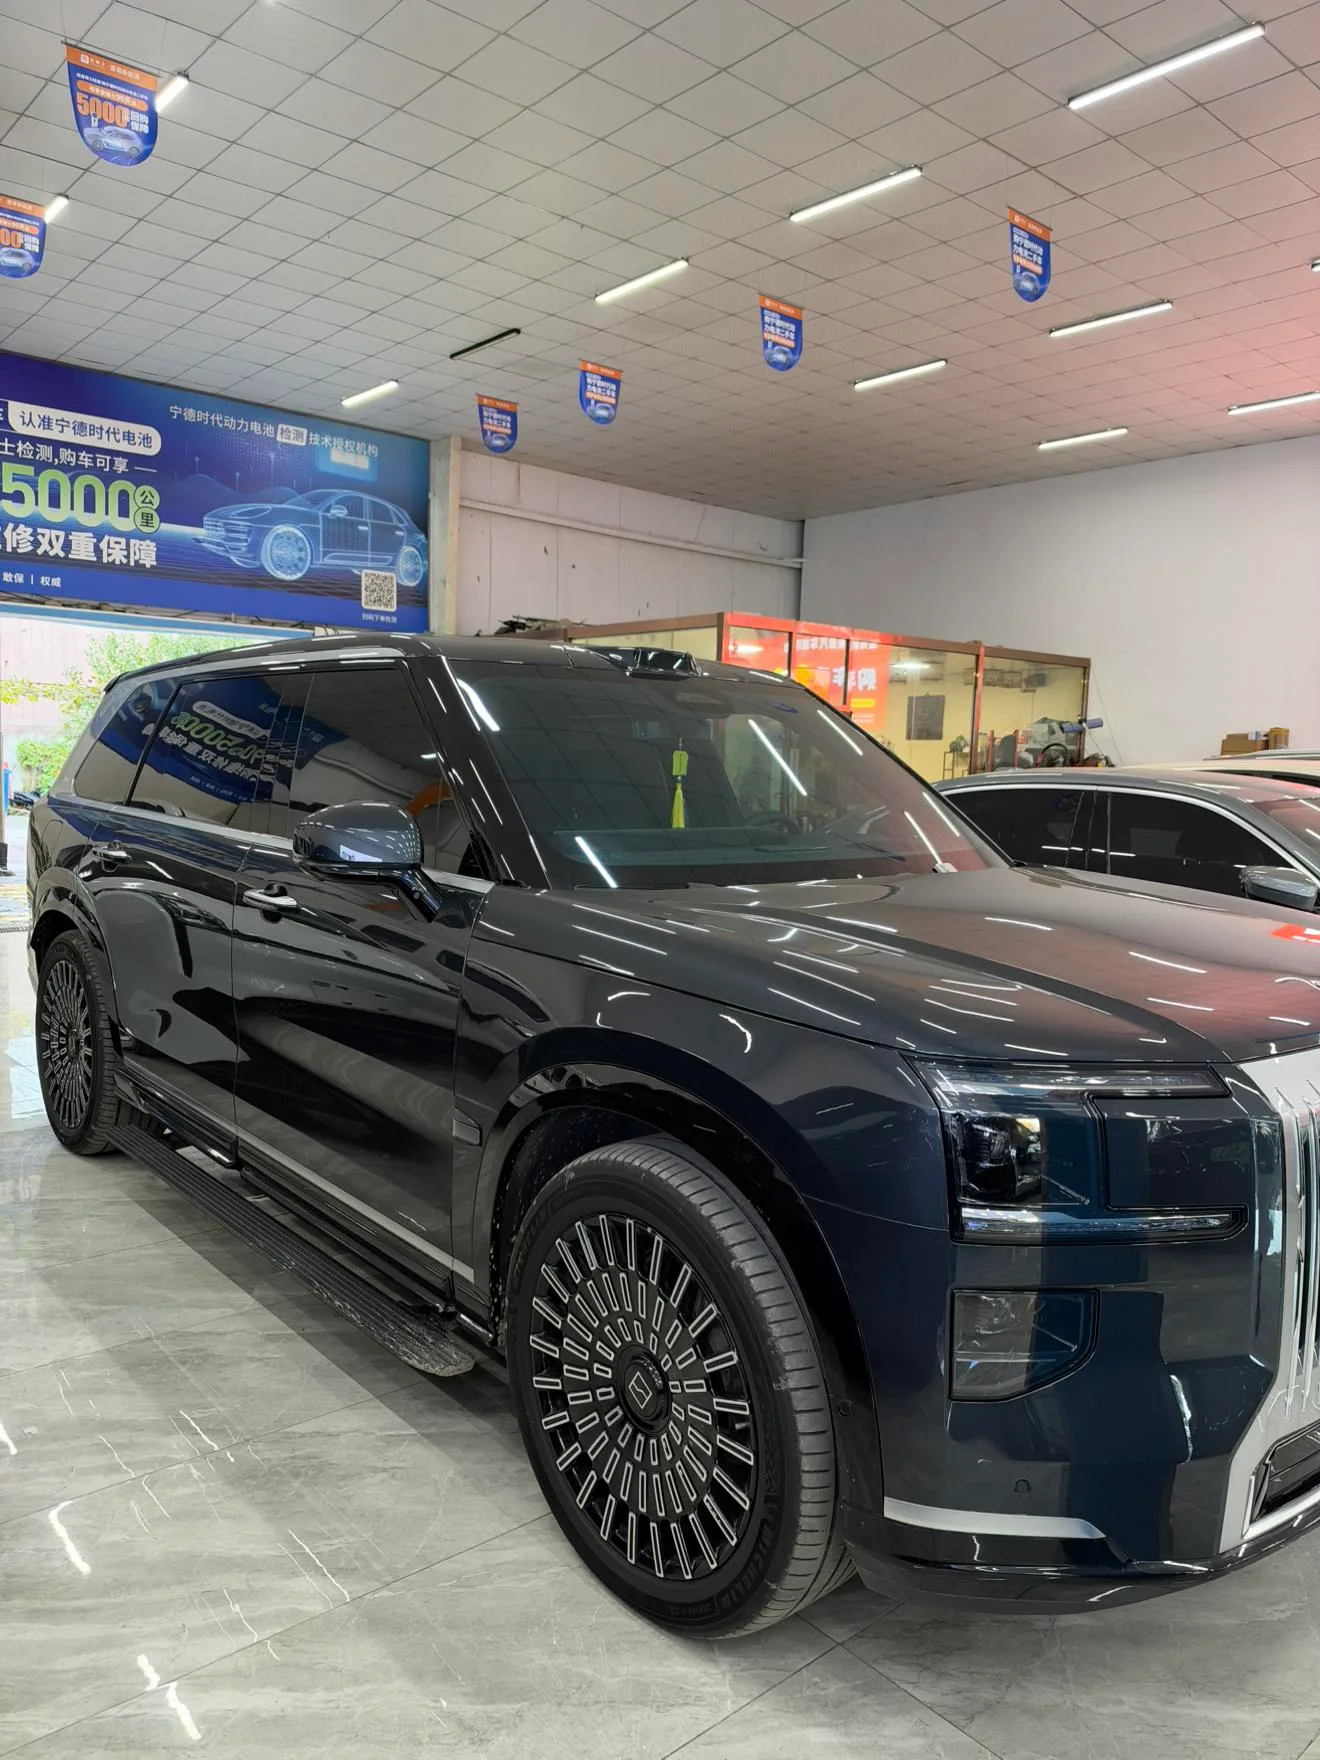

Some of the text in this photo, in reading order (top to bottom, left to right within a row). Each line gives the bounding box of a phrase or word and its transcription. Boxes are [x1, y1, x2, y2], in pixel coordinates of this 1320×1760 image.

[19, 410, 153, 449] 认准宁德时代电池
[2, 462, 138, 532] 5000
[0, 522, 157, 568] 修双重保障
[2, 571, 62, 588] 敢保 权威
[720, 1521, 772, 1610] MICHELIN
